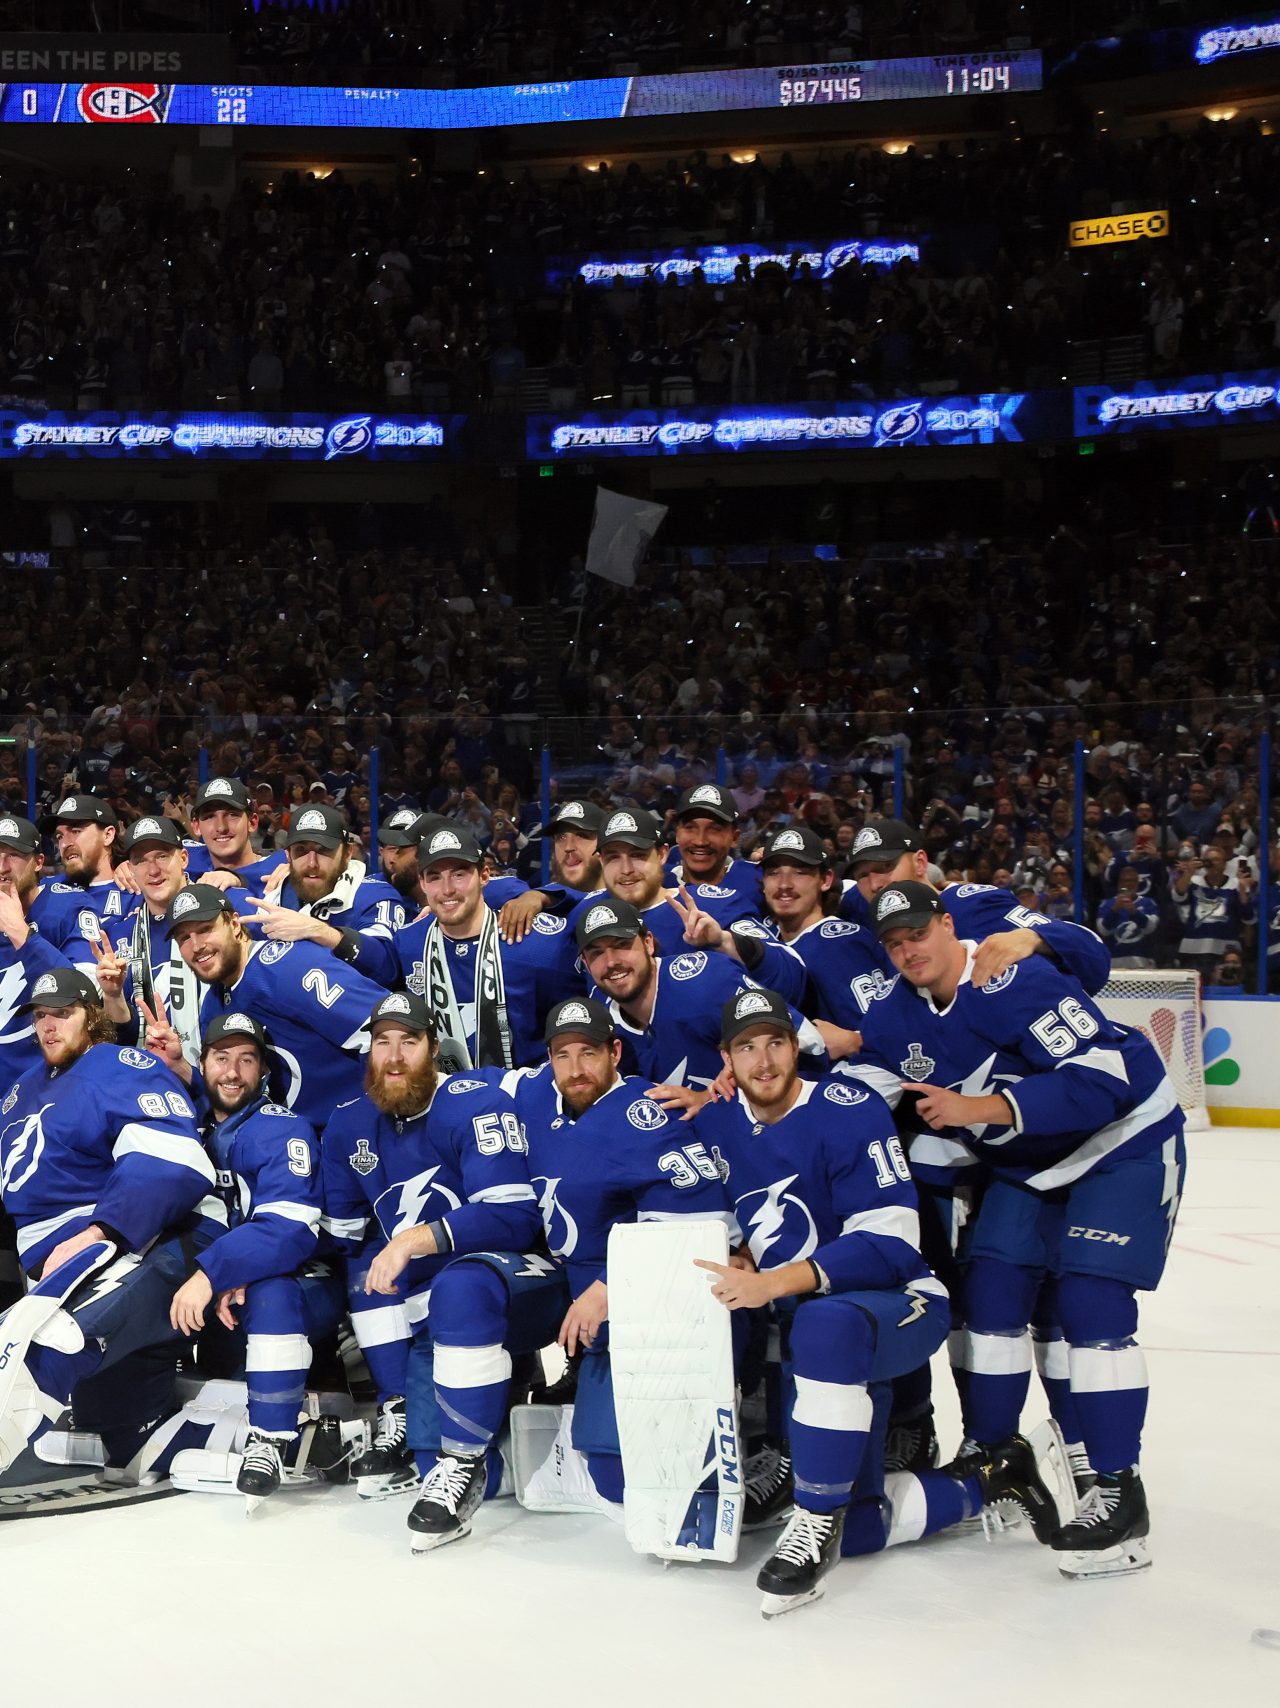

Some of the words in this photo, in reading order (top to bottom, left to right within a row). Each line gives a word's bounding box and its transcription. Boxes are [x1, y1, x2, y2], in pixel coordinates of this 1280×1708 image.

[58, 52, 110, 72] THE
[113, 53, 183, 73] PIPES
[821, 64, 864, 76] TOTAL
[210, 86, 254, 97] SHOTS
[513, 83, 572, 96] PENALTY
[780, 77, 861, 107] $87445
[945, 66, 1011, 93] 11:04
[22, 88, 37, 116] 0
[344, 88, 401, 100] PENALTY
[217, 97, 246, 123] 22
[1071, 219, 1146, 242] CHASE
[1098, 390, 1217, 421] STANLEY
[1215, 384, 1276, 412] CUP
[13, 423, 120, 447] STANLEY
[119, 423, 173, 448] CUP
[173, 423, 325, 450] CHAMPIONS
[374, 422, 444, 446] 2021
[551, 424, 660, 450] STANLEY
[658, 421, 713, 447] CUP
[713, 416, 873, 444] CHAMPIONS
[925, 406, 1001, 432] 2021
[103, 889, 123, 917] A
[301, 967, 345, 1010] 2
[1028, 995, 1100, 1059] 56
[903, 1060, 934, 1070] FINAL
[136, 1090, 195, 1119] 88
[472, 1112, 524, 1157] 58
[286, 1137, 312, 1178] 9
[351, 1155, 378, 1164] FINAL
[657, 1141, 721, 1190] 35
[866, 1135, 913, 1190] 16
[1066, 1225, 1132, 1246] CCM
[716, 1406, 740, 1485] CCM
